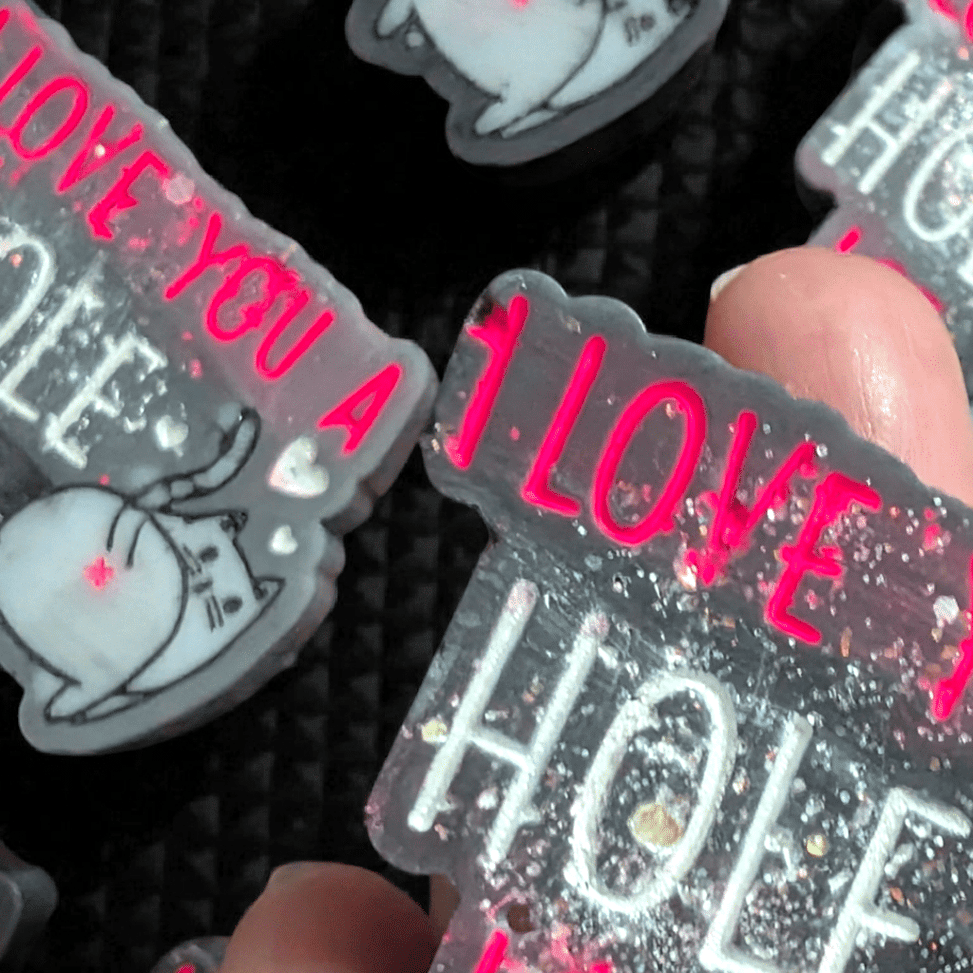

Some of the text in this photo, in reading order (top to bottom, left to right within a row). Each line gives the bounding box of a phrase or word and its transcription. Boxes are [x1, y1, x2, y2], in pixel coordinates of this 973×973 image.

[164, 212, 336, 381] YOU
[317, 363, 402, 455] A
[447, 294, 530, 470] I
[521, 334, 882, 646] LOVE
